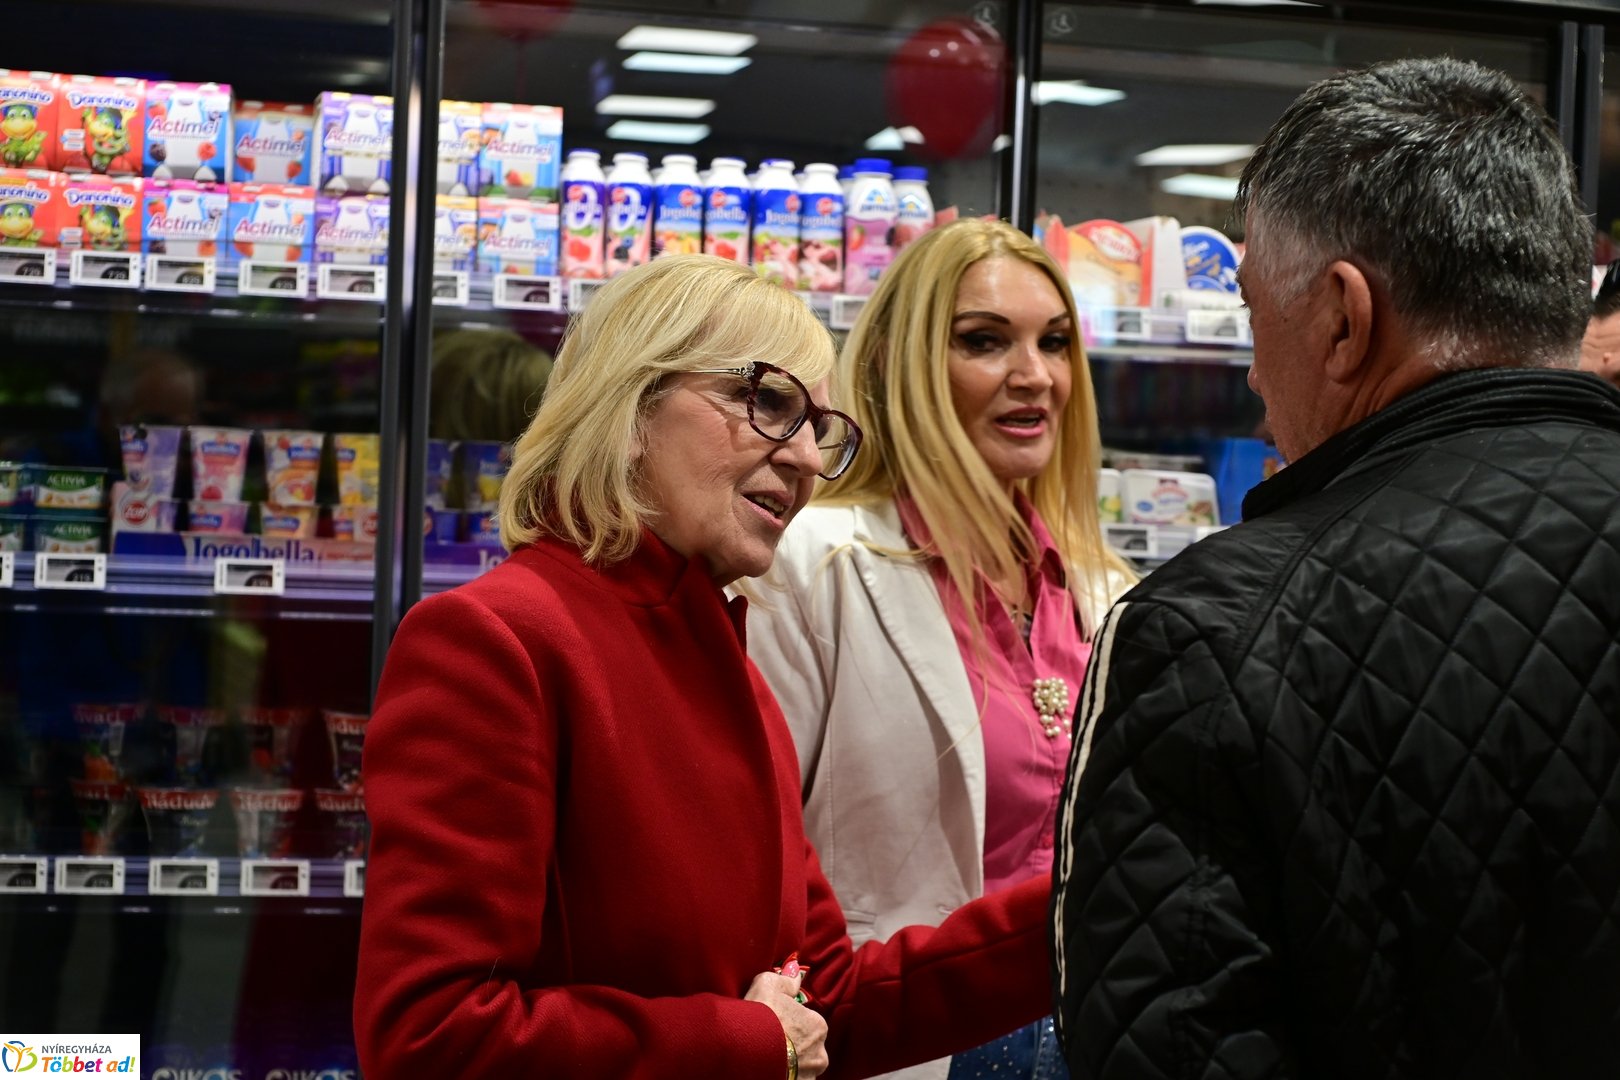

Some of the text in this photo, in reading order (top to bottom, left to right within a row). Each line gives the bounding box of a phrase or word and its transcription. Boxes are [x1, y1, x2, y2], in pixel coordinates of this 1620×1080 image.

[0, 88, 51, 102] anonino
[68, 93, 136, 109] Danonino
[149, 117, 219, 134] Actimel
[237, 134, 304, 153] Actimel
[486, 138, 554, 156] Actimel
[0, 187, 49, 201] anonino
[66, 189, 134, 207] Danonino
[149, 213, 219, 231] Actimel
[236, 218, 304, 236] Actimel
[484, 233, 552, 251] Actimel
